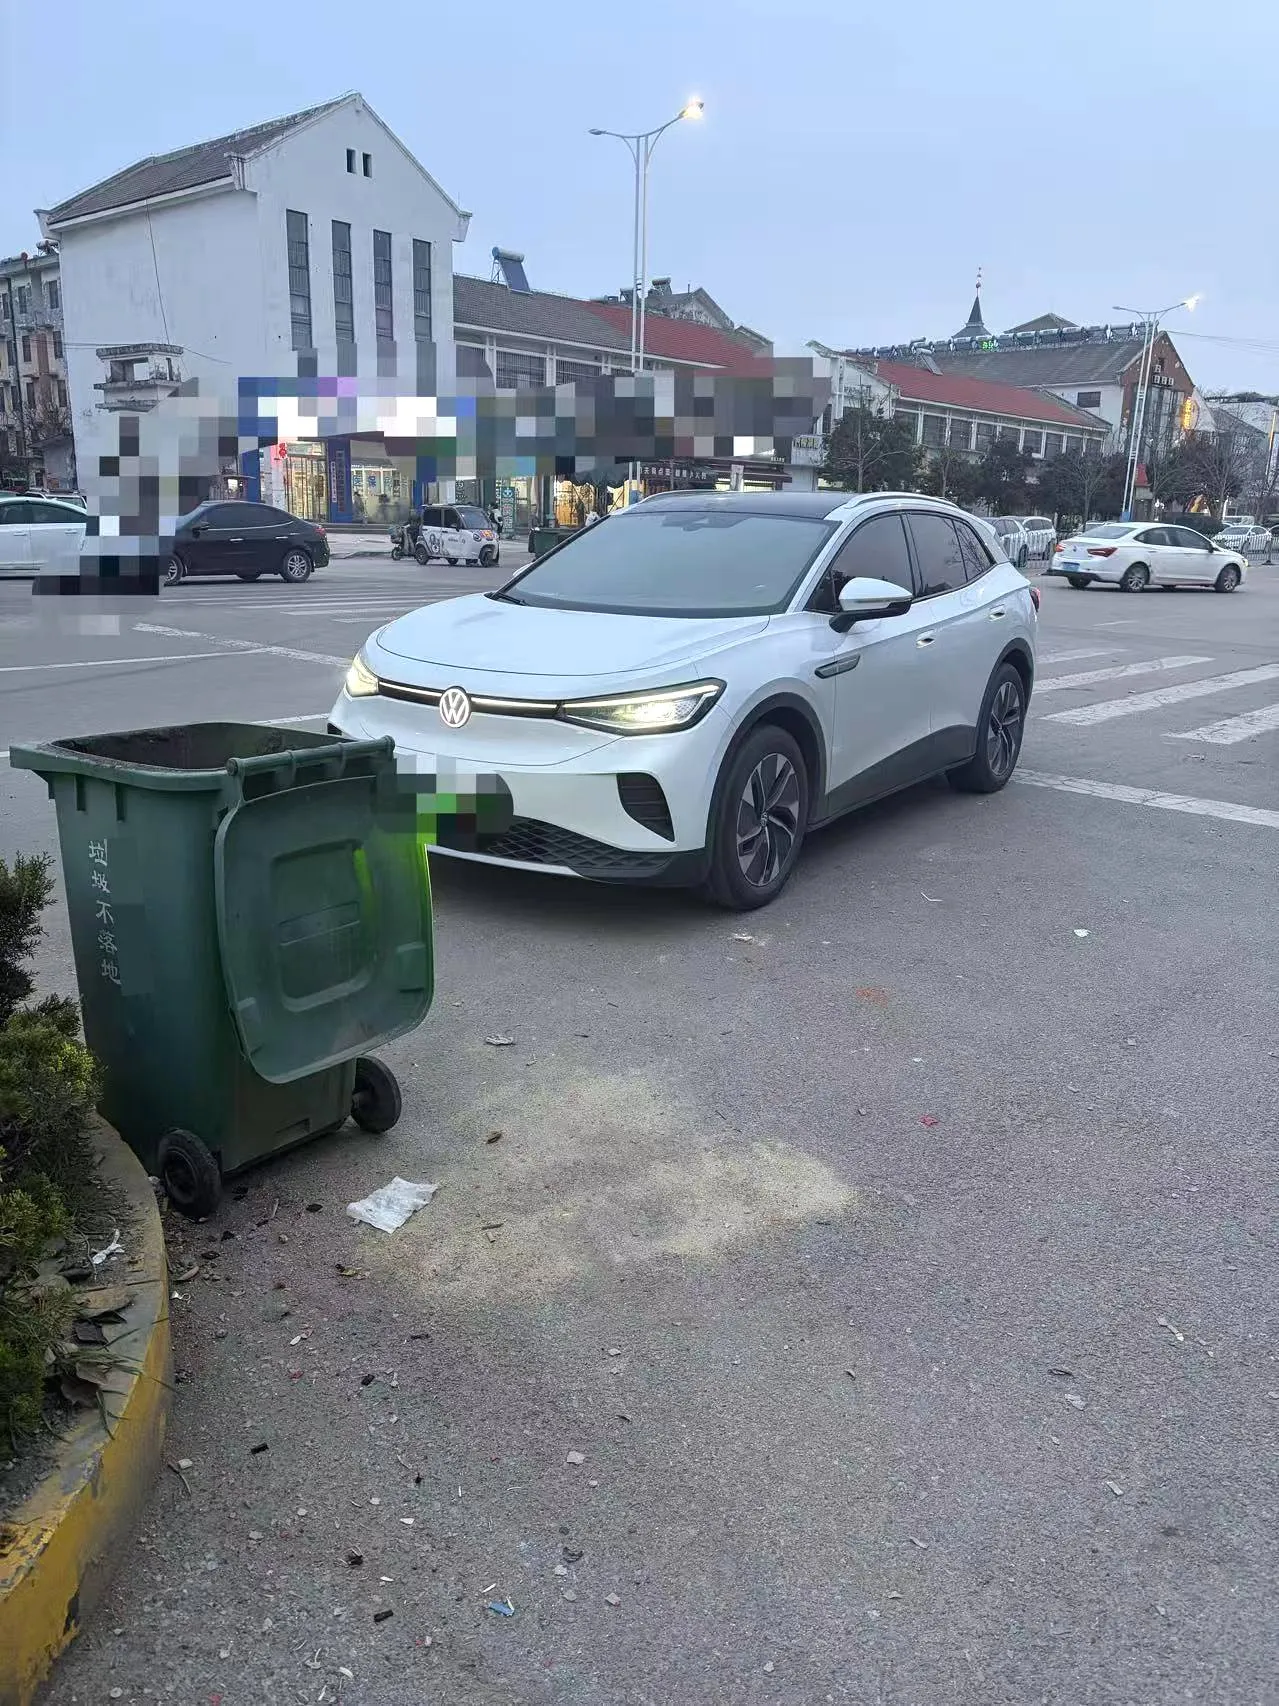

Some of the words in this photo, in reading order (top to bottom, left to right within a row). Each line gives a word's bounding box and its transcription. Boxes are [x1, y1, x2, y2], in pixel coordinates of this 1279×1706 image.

[440, 688, 470, 728] VW
[88, 838, 122, 985] 垃圾不落地
